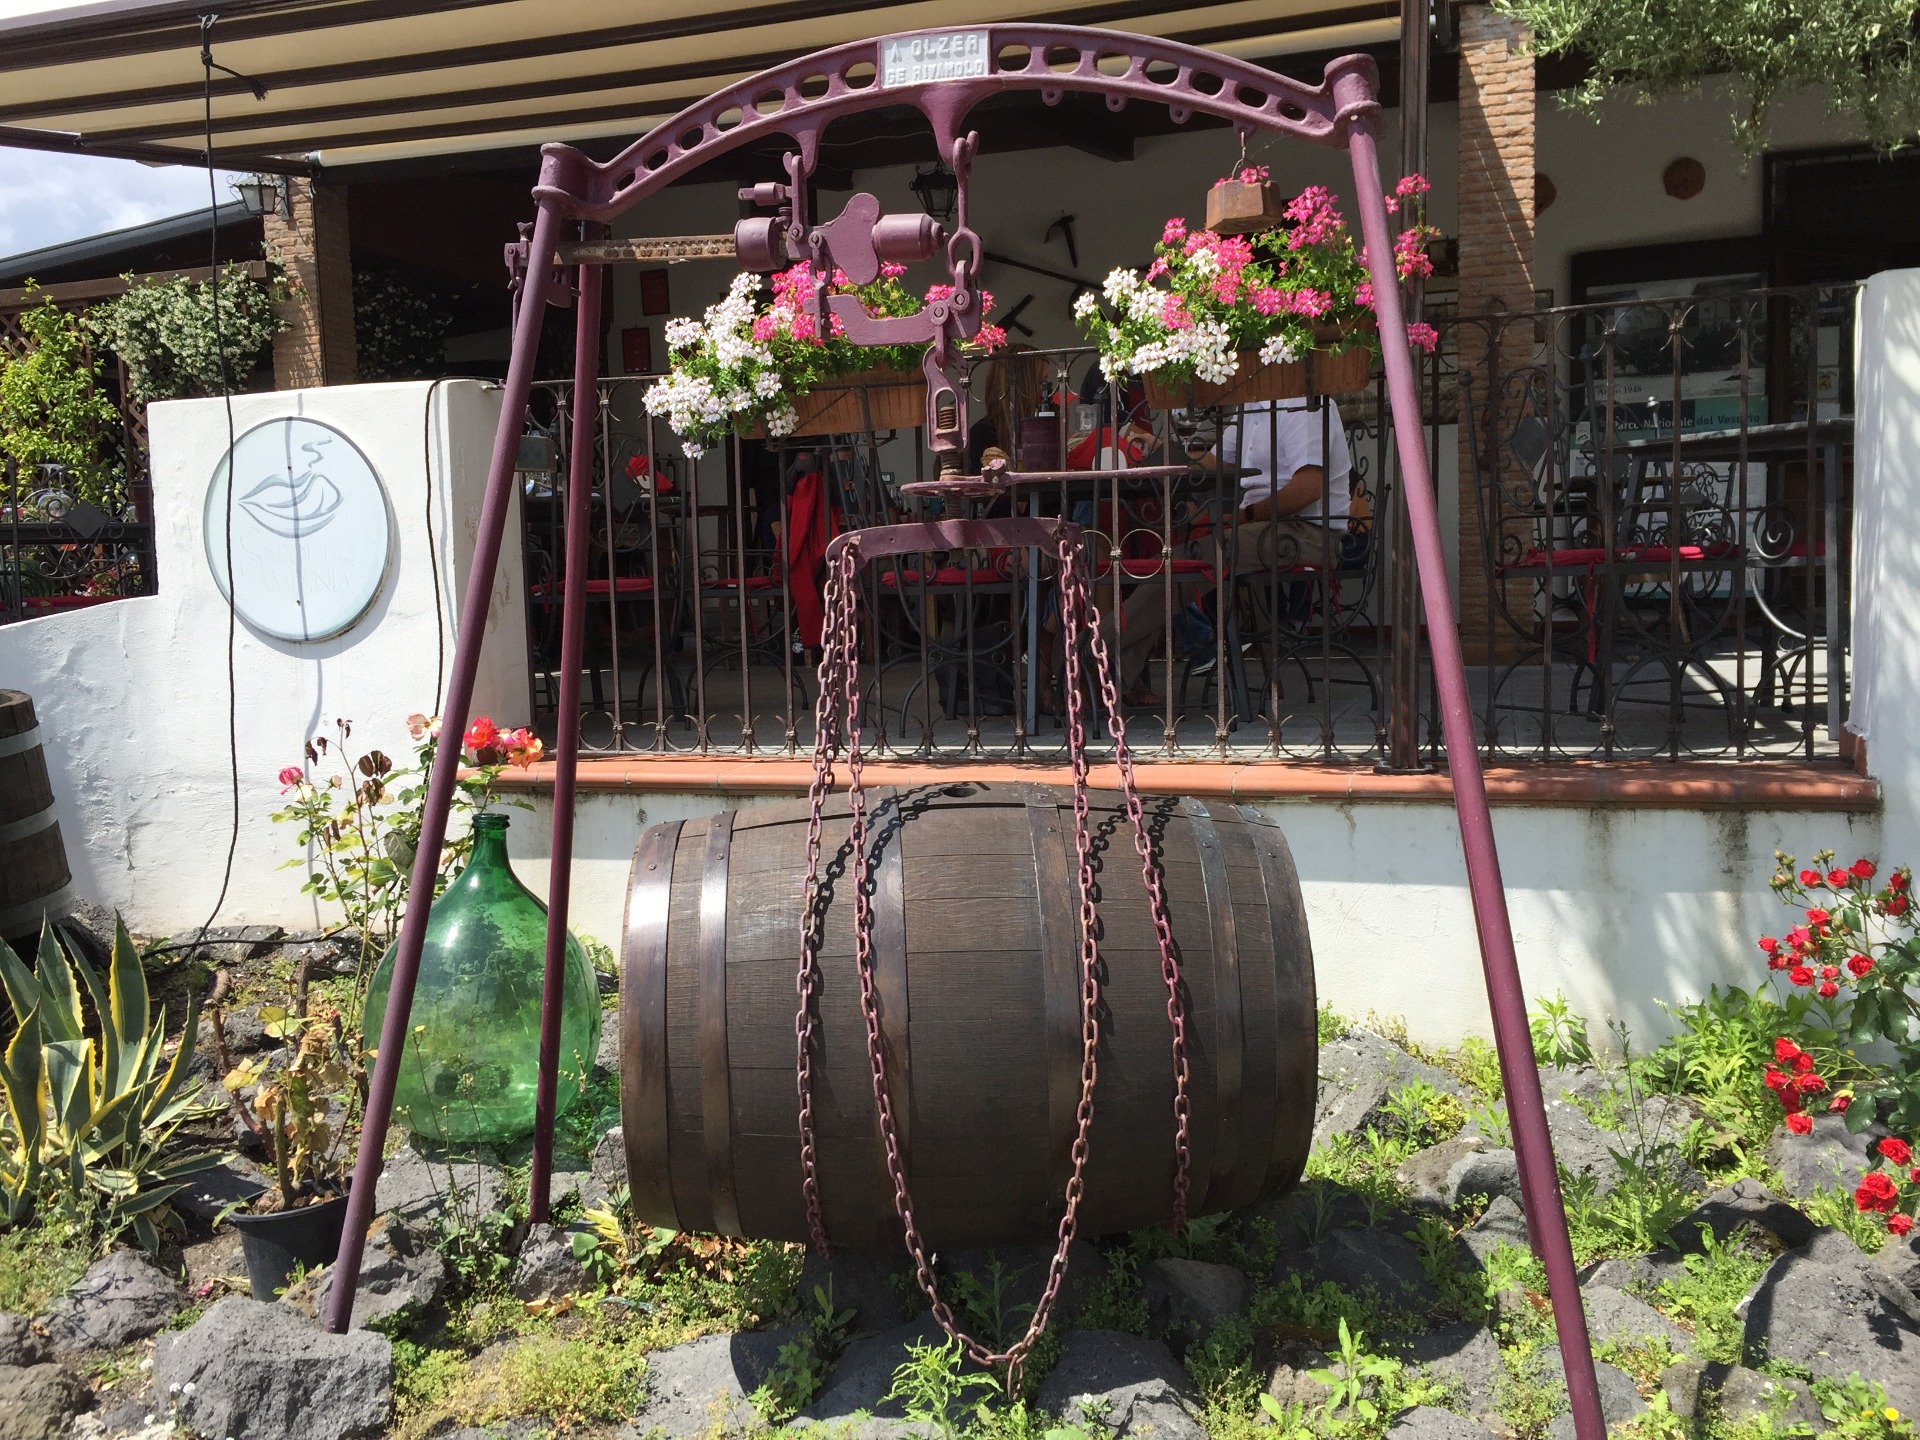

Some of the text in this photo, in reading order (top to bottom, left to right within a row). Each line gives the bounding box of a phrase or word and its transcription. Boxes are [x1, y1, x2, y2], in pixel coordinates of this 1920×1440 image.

[891, 34, 980, 63] A OLZER
[886, 67, 907, 85] GE
[1624, 385, 1642, 394] 1948
[1644, 417, 1693, 428] Nzioale
[1696, 415, 1713, 425] del
[1717, 413, 1760, 425] Vesuio
